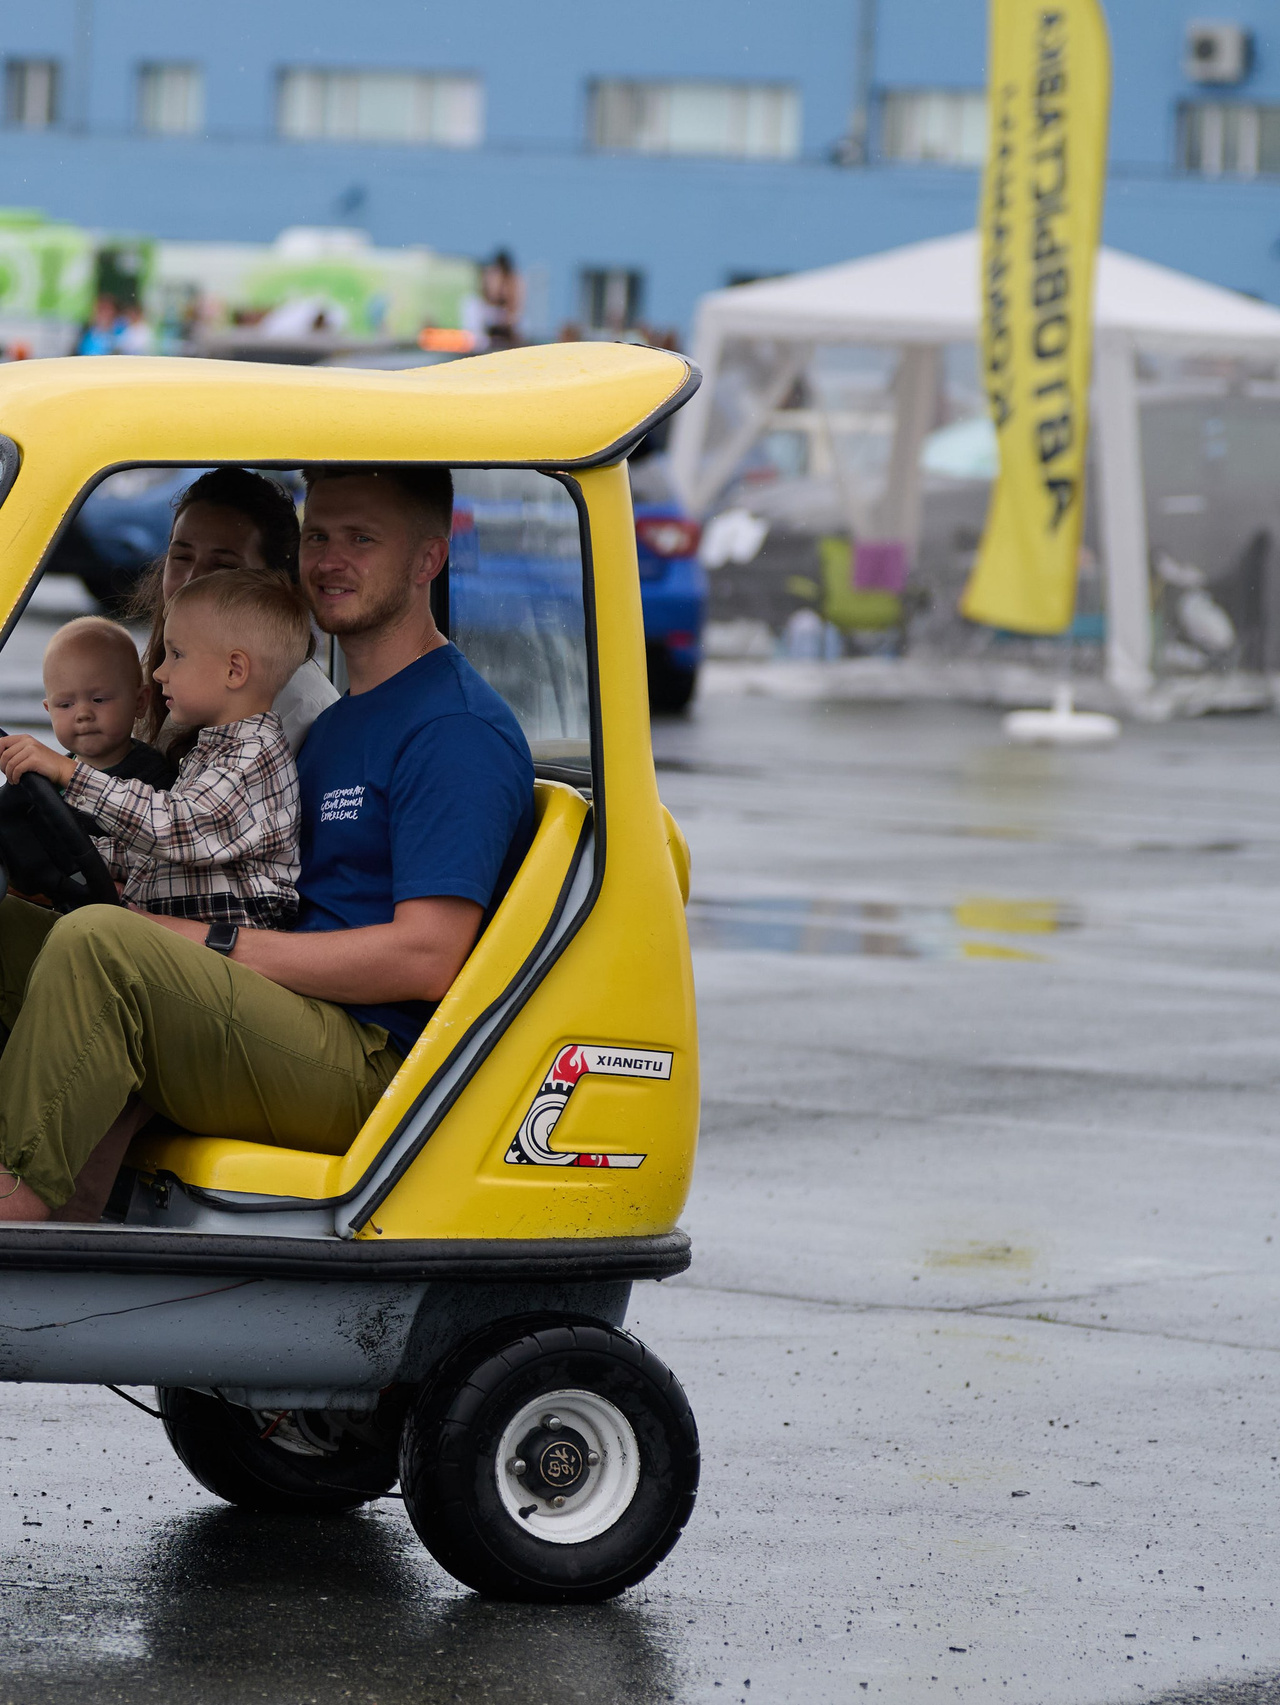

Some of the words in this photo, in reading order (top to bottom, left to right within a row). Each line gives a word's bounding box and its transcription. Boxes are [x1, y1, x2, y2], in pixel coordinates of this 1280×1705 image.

[323, 785, 365, 800] CONTEMPORARY
[320, 799, 339, 811] CASUAL
[338, 797, 363, 809] BRUNCH
[321, 809, 359, 822] EXPERIENCE
[596, 1055, 663, 1072] XIANGTU
